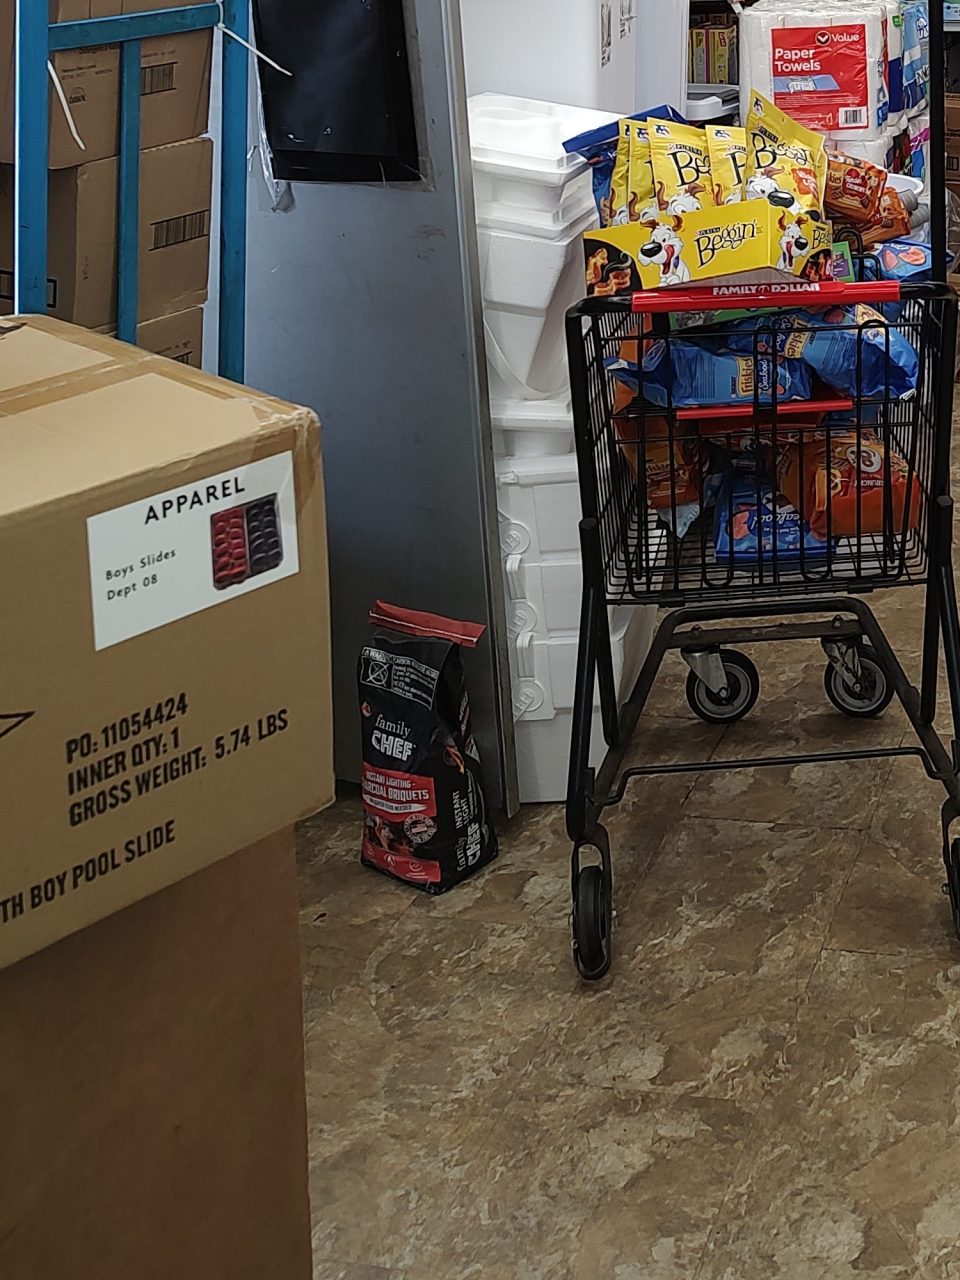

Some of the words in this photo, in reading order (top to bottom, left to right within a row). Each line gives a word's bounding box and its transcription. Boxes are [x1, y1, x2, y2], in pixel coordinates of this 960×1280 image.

[831, 33, 860, 43] Value
[774, 48, 816, 61] Paper
[774, 60, 821, 72] Towels
[675, 144, 704, 157] PURINA
[712, 286, 758, 296] FAMILY
[771, 283, 820, 293] DOLLAR
[740, 357, 754, 394] Friskies
[759, 357, 769, 392] Seafood
[144, 477, 246, 526] APPAREL
[105, 564, 135, 581] Boys
[139, 548, 177, 569] Slides
[107, 581, 137, 601] Dept
[142, 573, 159, 588] 08
[66, 732, 98, 764] PO:
[101, 692, 189, 749] 11054424
[375, 714, 411, 739] family
[68, 751, 127, 796] INNER
[131, 733, 168, 768] QTY:
[171, 726, 180, 749] 1
[371, 730, 413, 761] CHEF
[69, 780, 131, 827] GROSS
[135, 746, 207, 797] WEIGHT:
[214, 724, 252, 760] 5.74
[257, 708, 289, 741] LBS
[386, 777, 411, 789] LIGHTING
[388, 789, 429, 802] BRIQUETS
[453, 791, 461, 829] INSTANT
[461, 798, 470, 826] LIGHT
[456, 836, 467, 871] family
[466, 822, 481, 866] CHEF
[30, 871, 68, 910] BOY
[72, 849, 122, 890] POOL
[124, 819, 176, 863] SLIDE
